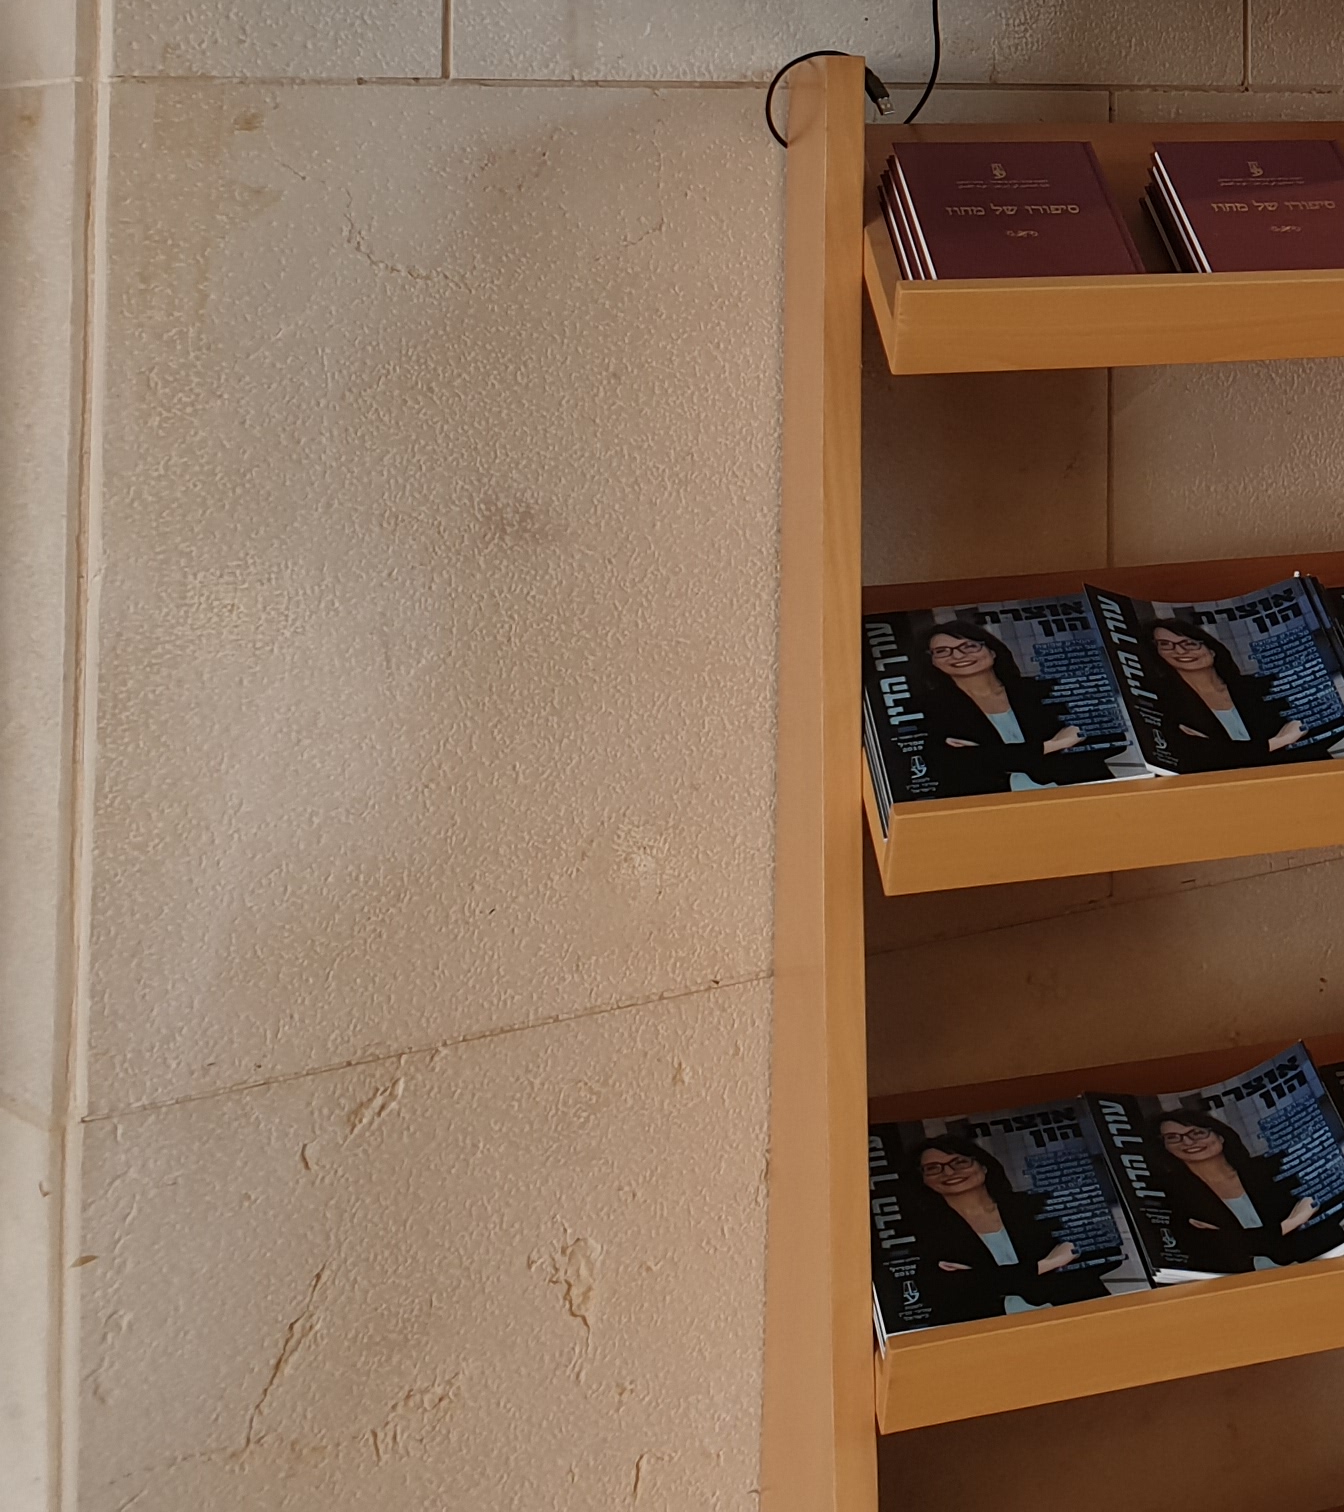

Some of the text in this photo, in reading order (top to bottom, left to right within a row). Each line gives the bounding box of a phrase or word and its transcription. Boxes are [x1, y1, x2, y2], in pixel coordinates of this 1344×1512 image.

[990, 202, 1018, 215] של
[1251, 199, 1278, 211] של
[1038, 616, 1091, 637] הון
[1097, 594, 1138, 645] עורך
[1252, 602, 1302, 634] הון
[865, 622, 909, 672] עורך
[1116, 650, 1159, 700] הדין
[880, 676, 924, 725] הדין
[1258, 1069, 1308, 1109] הון
[1029, 1122, 1083, 1148] הון
[1098, 1099, 1143, 1148] עורך
[1119, 1152, 1166, 1199] הדין
[871, 1196, 916, 1249] הדין
